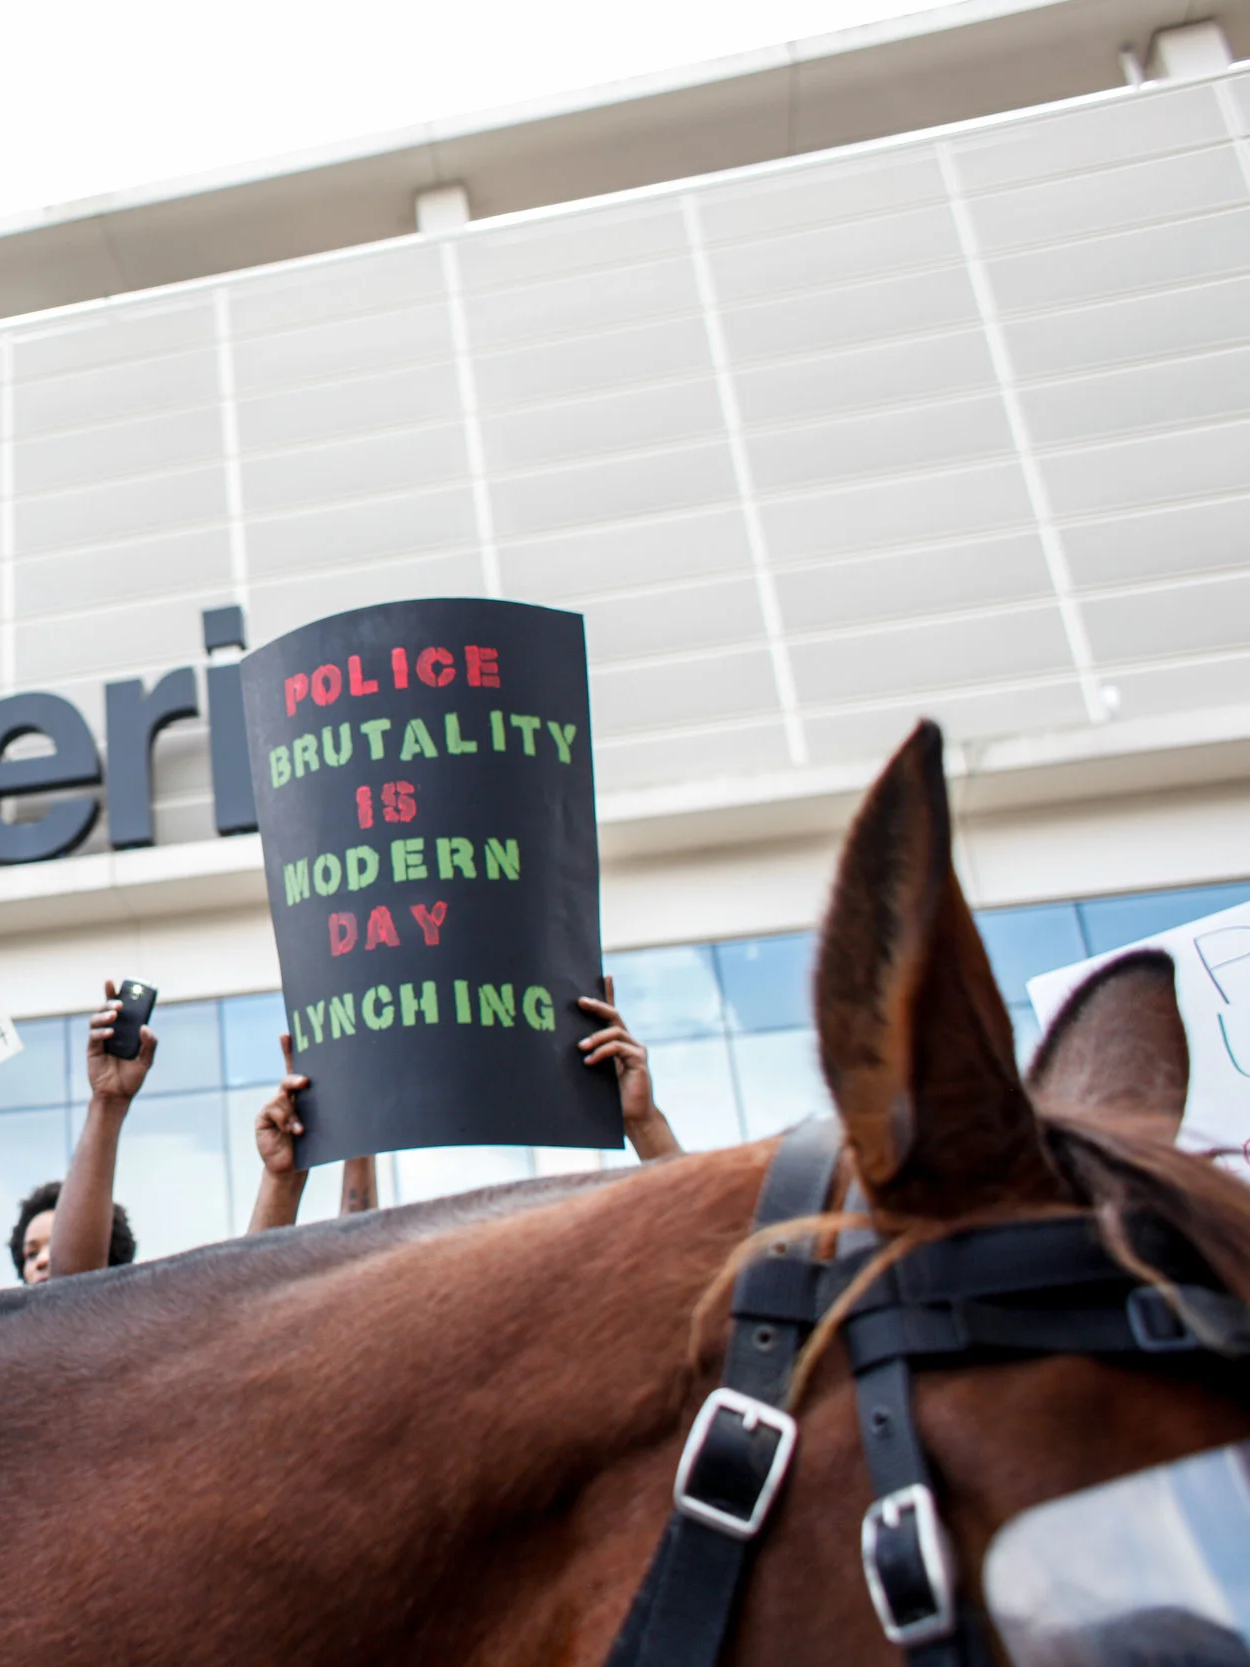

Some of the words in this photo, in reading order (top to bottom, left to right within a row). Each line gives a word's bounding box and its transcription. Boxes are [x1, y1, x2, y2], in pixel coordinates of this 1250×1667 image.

[284, 645, 501, 717] POLICE
[270, 710, 577, 789] BRUTALITY
[356, 780, 418, 829] IS
[284, 837, 521, 906] MODERN
[328, 901, 448, 957] DAY
[292, 980, 556, 1053] LYNCHING
